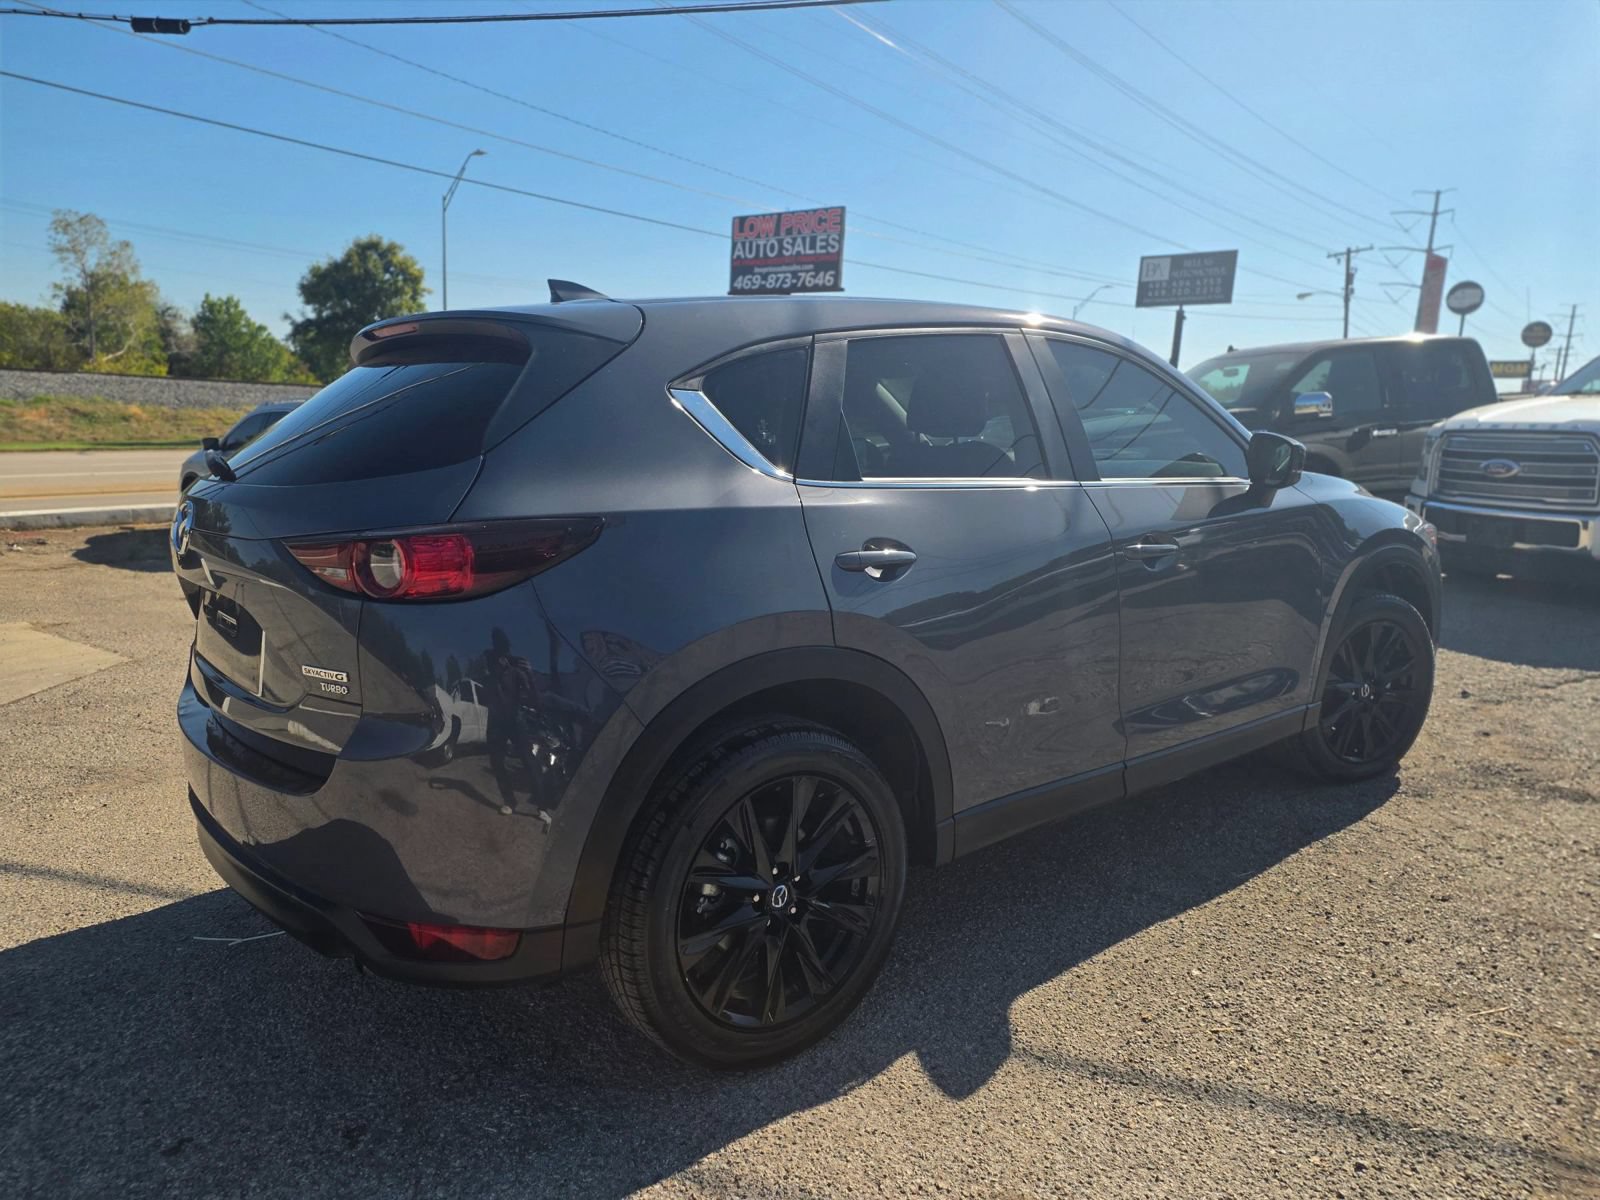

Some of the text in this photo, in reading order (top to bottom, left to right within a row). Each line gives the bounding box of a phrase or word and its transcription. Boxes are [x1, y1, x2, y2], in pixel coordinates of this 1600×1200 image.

[734, 208, 842, 240] LOW PRICE
[733, 234, 840, 259] AUTO SALES
[733, 271, 836, 290] 469-873-7646
[320, 682, 348, 695] TURBO
